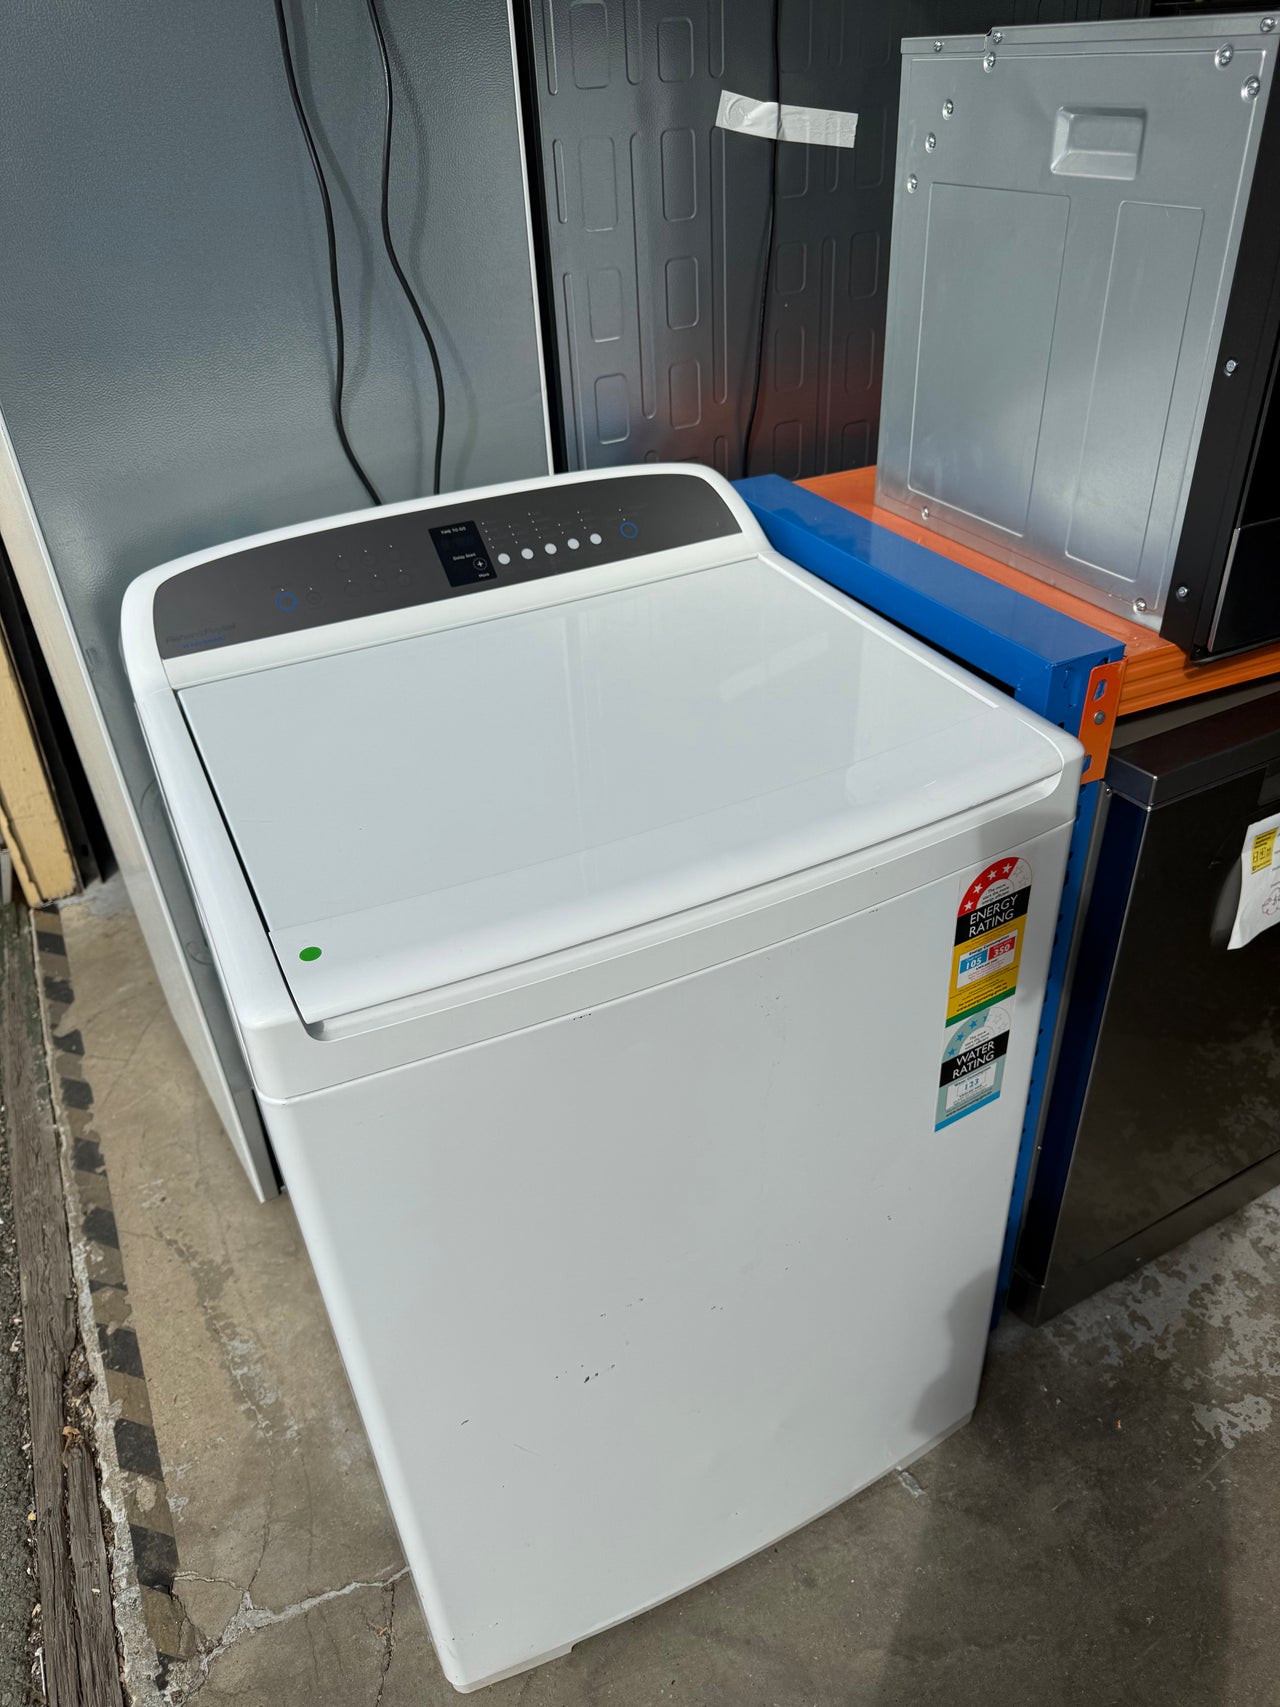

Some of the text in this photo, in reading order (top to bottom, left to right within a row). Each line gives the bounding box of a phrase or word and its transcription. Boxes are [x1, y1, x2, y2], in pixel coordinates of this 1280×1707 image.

[968, 909, 1015, 938] RATING
[970, 894, 1019, 925] ENERGY
[965, 957, 982, 970] 105
[993, 943, 1011, 958] 350
[952, 1050, 995, 1079] RATING
[956, 1040, 995, 1066] WATER
[964, 1077, 980, 1091] 123
